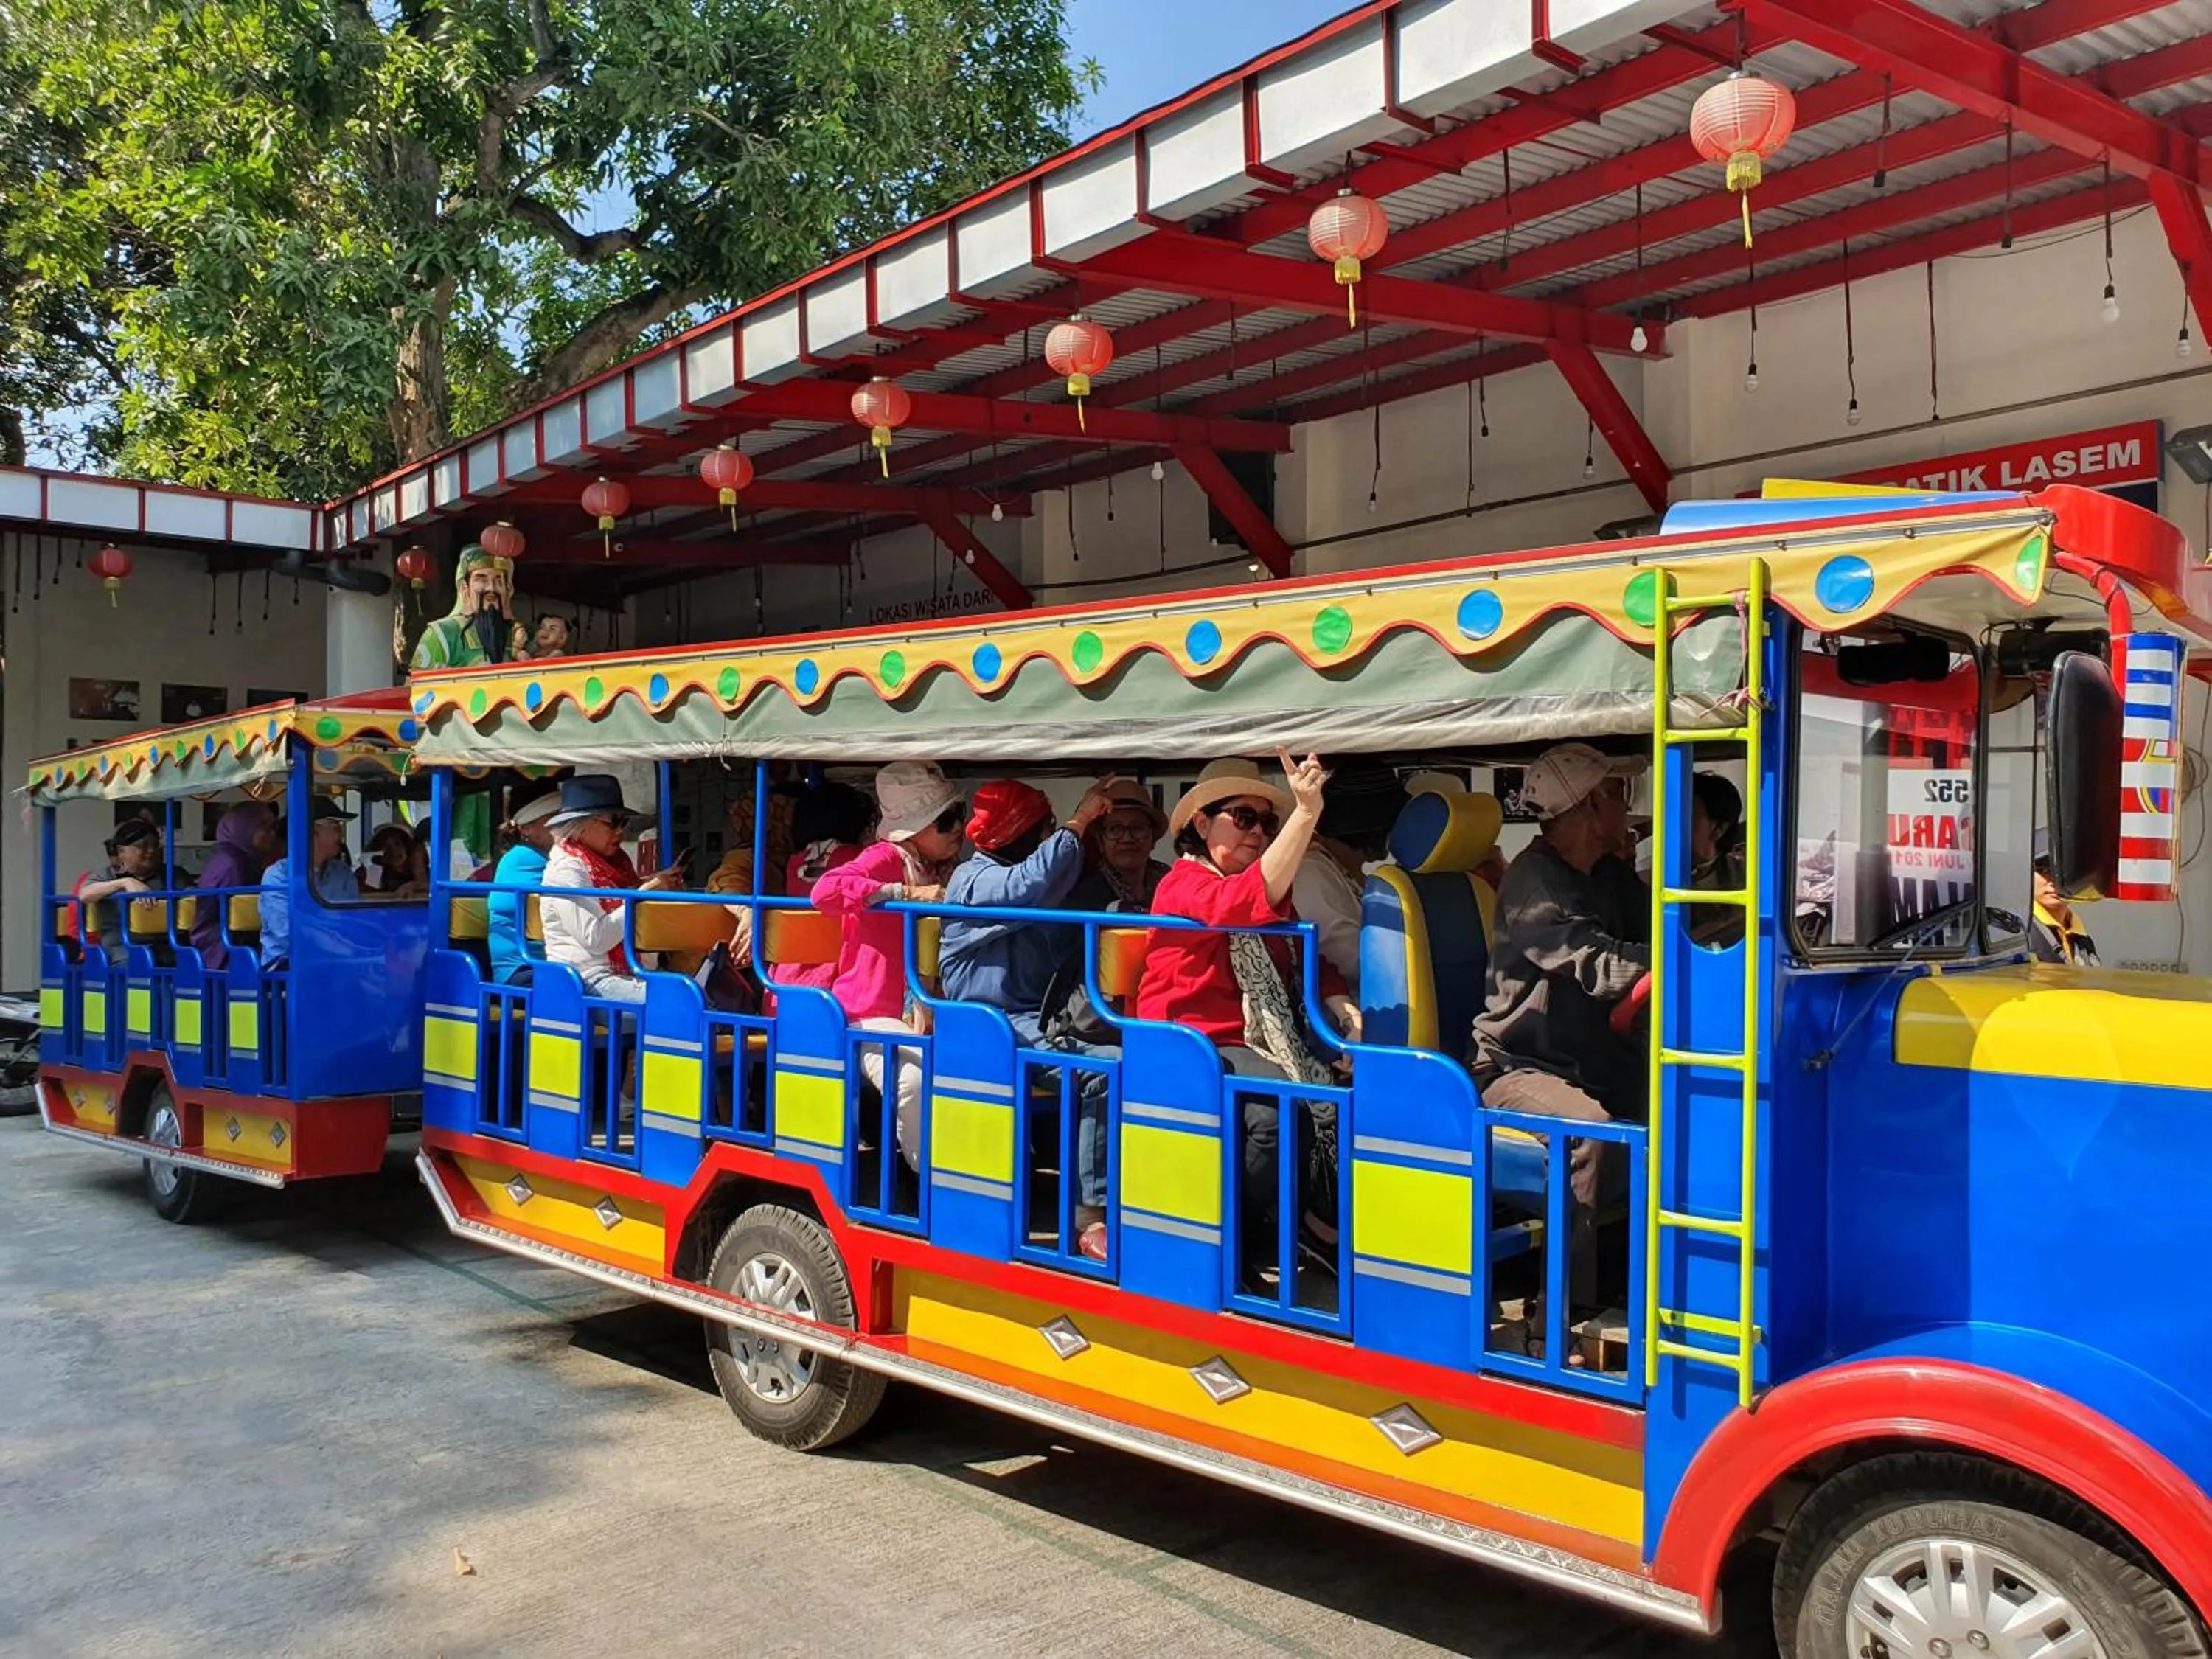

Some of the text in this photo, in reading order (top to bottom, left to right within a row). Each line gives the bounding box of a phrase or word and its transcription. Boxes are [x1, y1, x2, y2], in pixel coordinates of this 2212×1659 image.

[1880, 439, 2141, 492] TIK LASEM
[869, 600, 912, 624] LOKASI
[915, 593, 960, 618] WISATA
